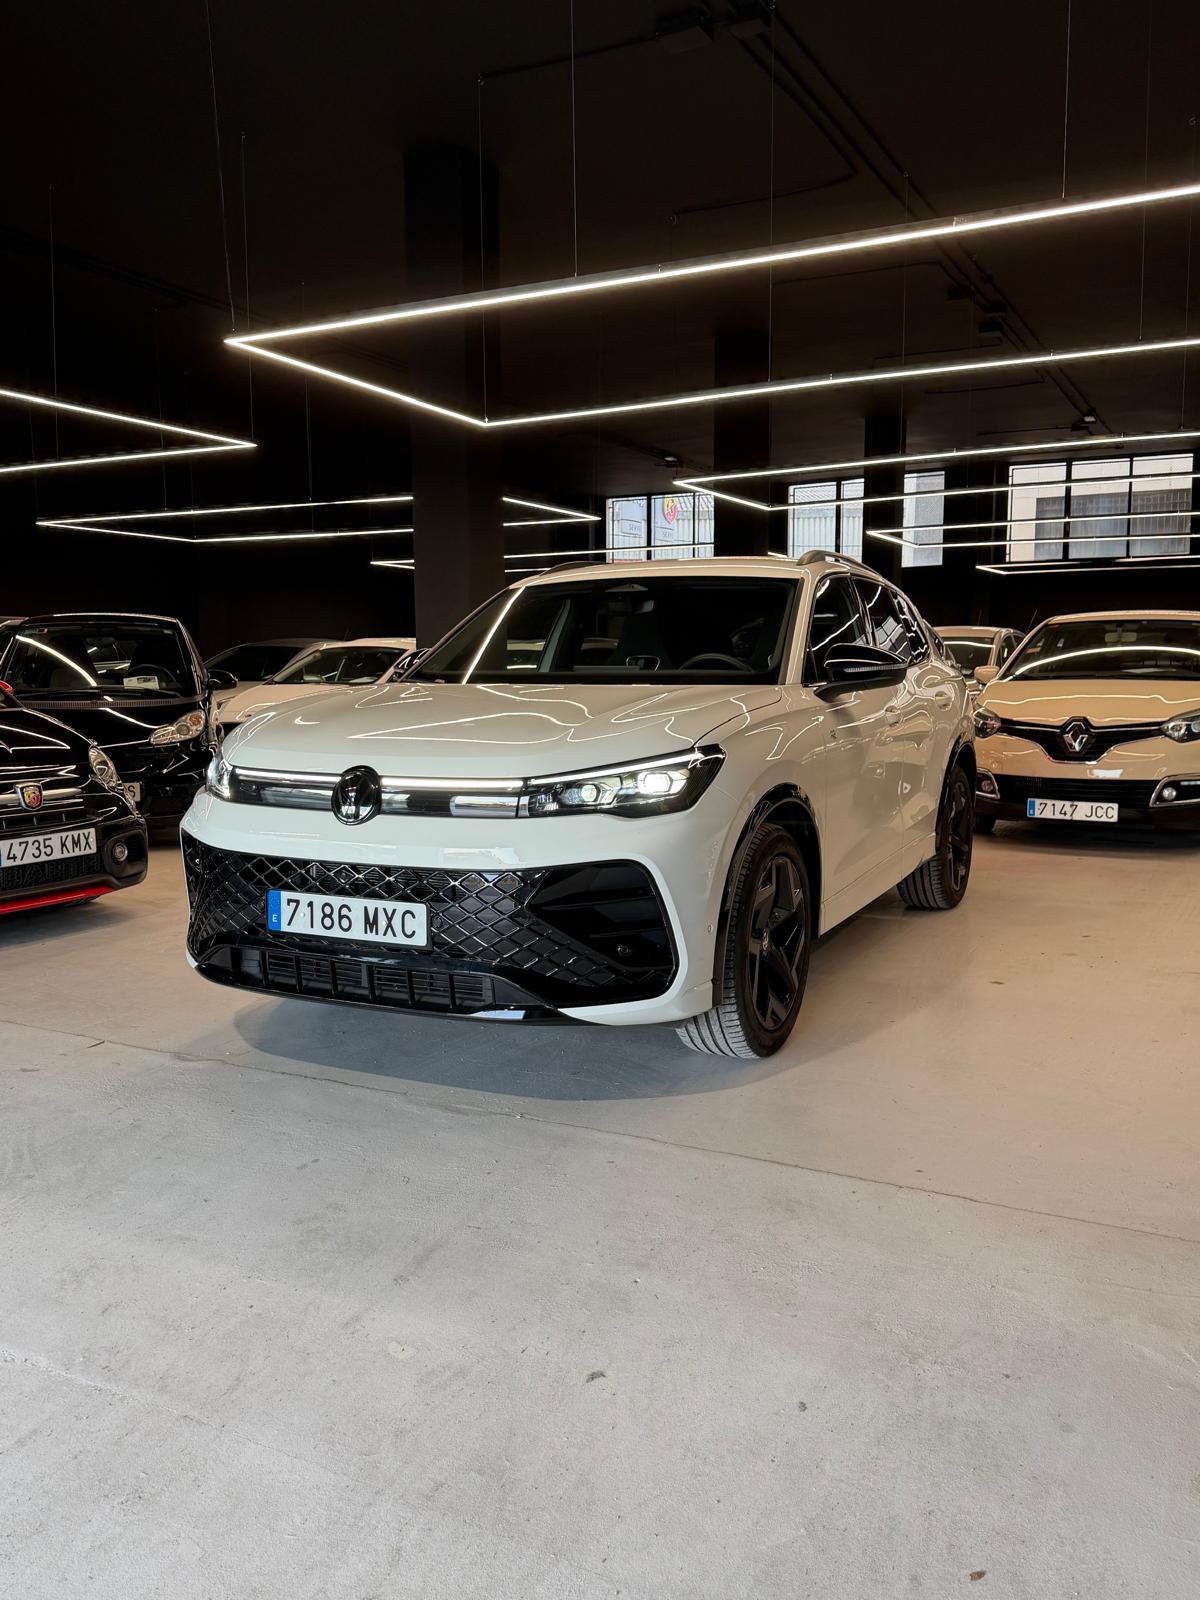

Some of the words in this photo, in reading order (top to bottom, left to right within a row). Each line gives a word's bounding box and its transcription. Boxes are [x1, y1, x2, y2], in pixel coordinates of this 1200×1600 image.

[1039, 802, 1078, 817] 7147
[1085, 805, 1115, 819] JCC
[6, 837, 54, 862] 4735
[60, 831, 93, 855] KMX
[272, 914, 278, 923] E
[286, 898, 352, 932] 7186
[363, 905, 416, 939] MXC
